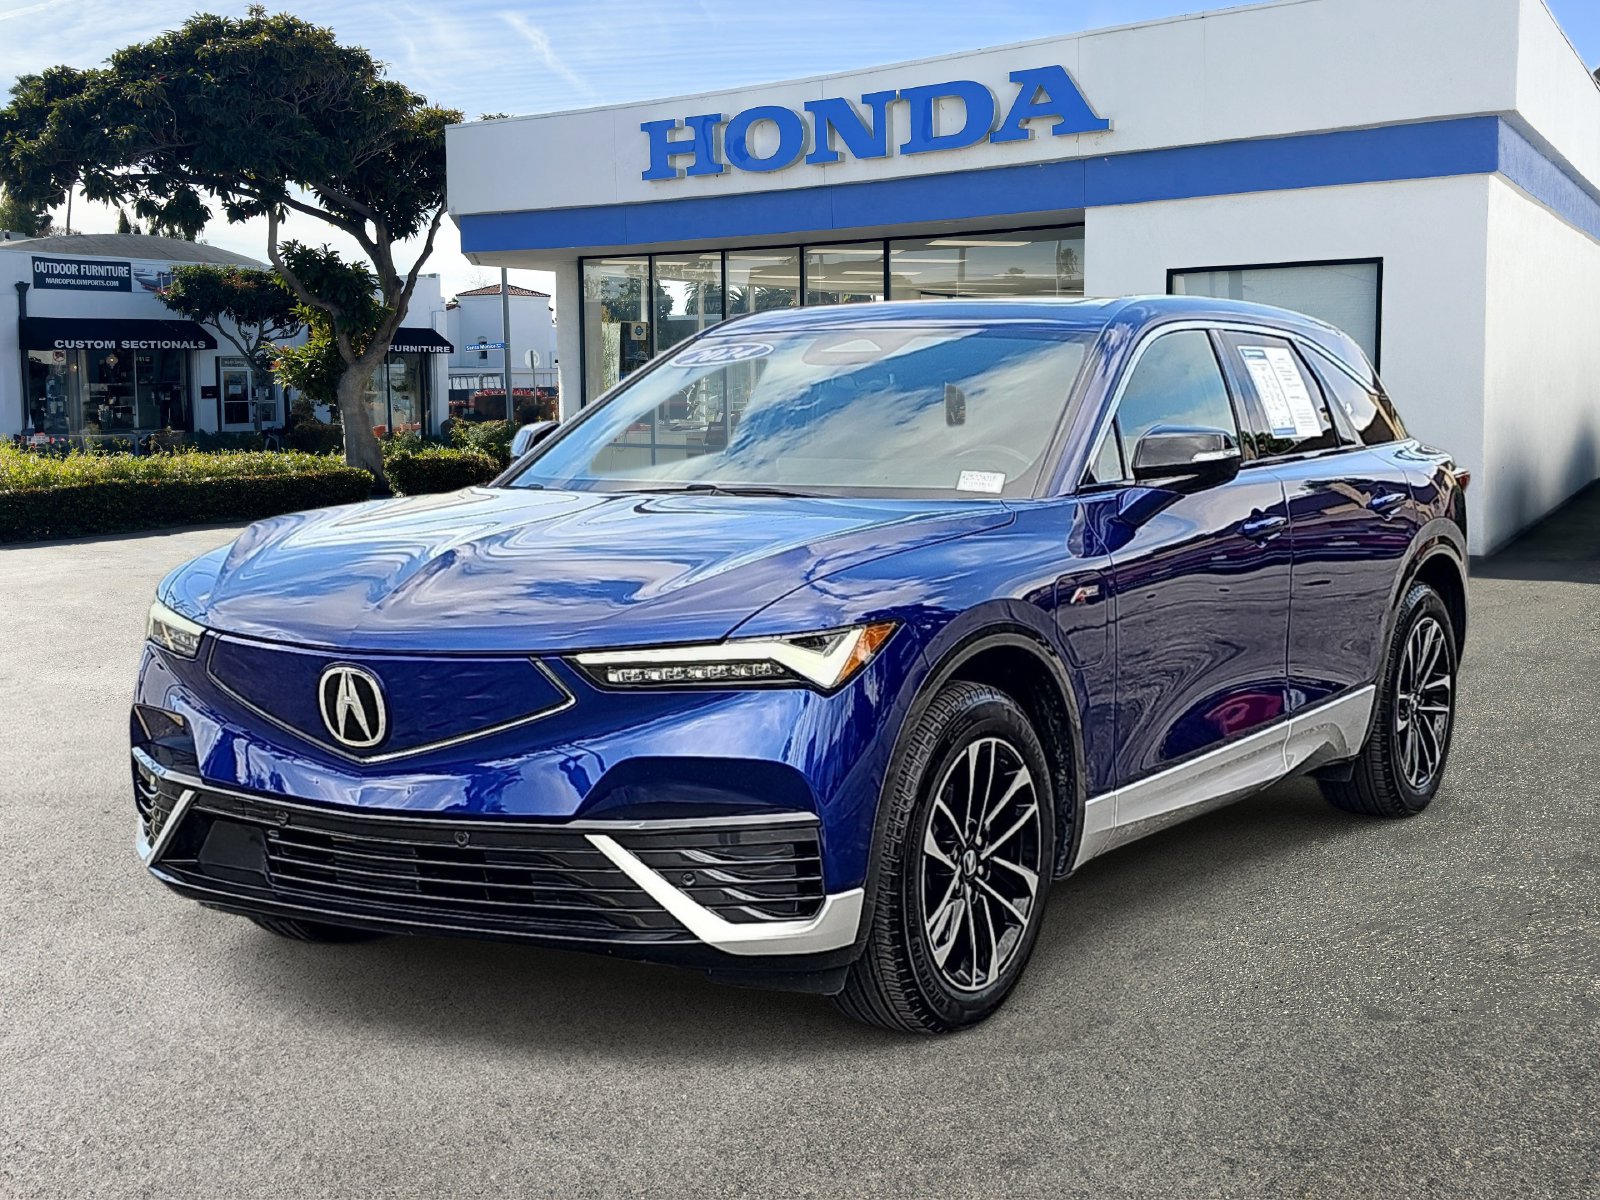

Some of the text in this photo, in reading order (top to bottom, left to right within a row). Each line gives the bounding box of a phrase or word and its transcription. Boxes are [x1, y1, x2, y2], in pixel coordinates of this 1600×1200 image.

[640, 65, 1113, 181] HONDA
[34, 261, 130, 278] OUTDOOR FURNITURE
[45, 277, 119, 287] MARCOPOLOIMPORTS.COM
[54, 339, 206, 349] CUSTOM SECTIONALS
[388, 344, 451, 353] FURNITURE
